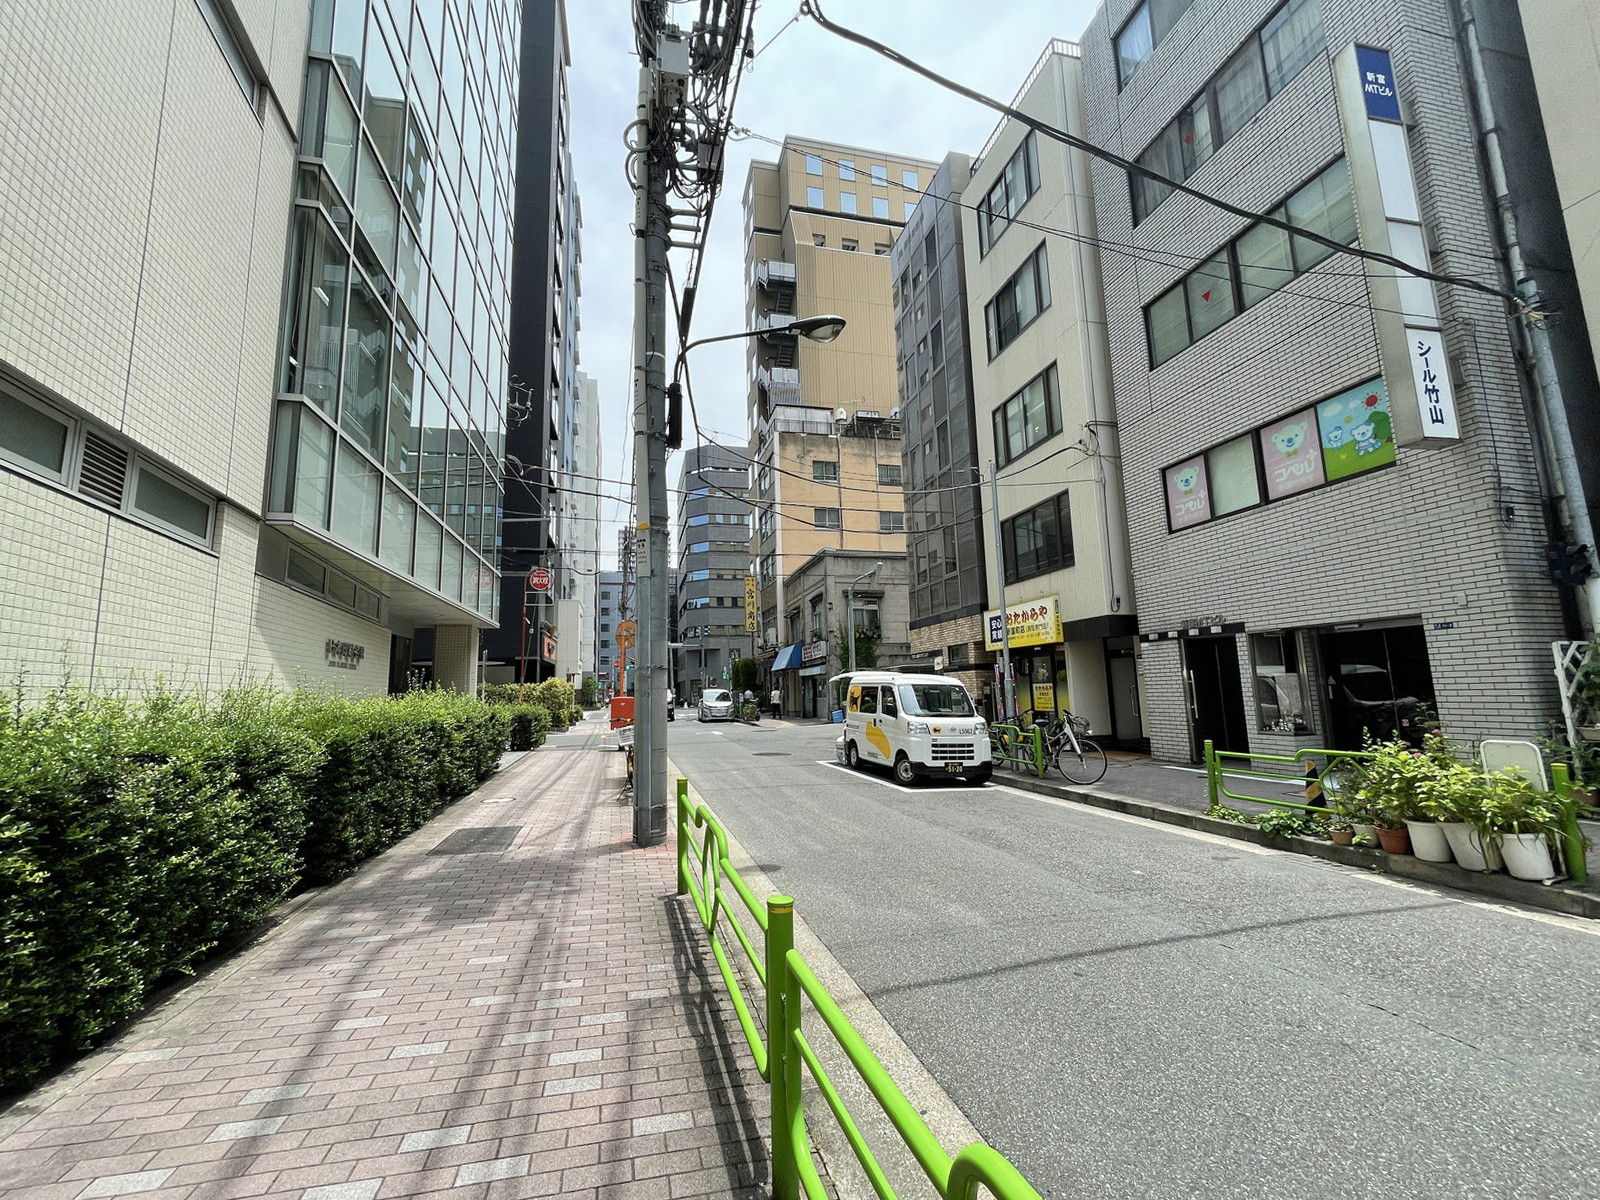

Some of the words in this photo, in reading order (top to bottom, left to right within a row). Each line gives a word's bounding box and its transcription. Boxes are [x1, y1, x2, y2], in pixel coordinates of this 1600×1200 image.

[1365, 83, 1393, 97] MTビル
[1417, 340, 1444, 424] シール竹山
[1005, 605, 1048, 626] おたからや
